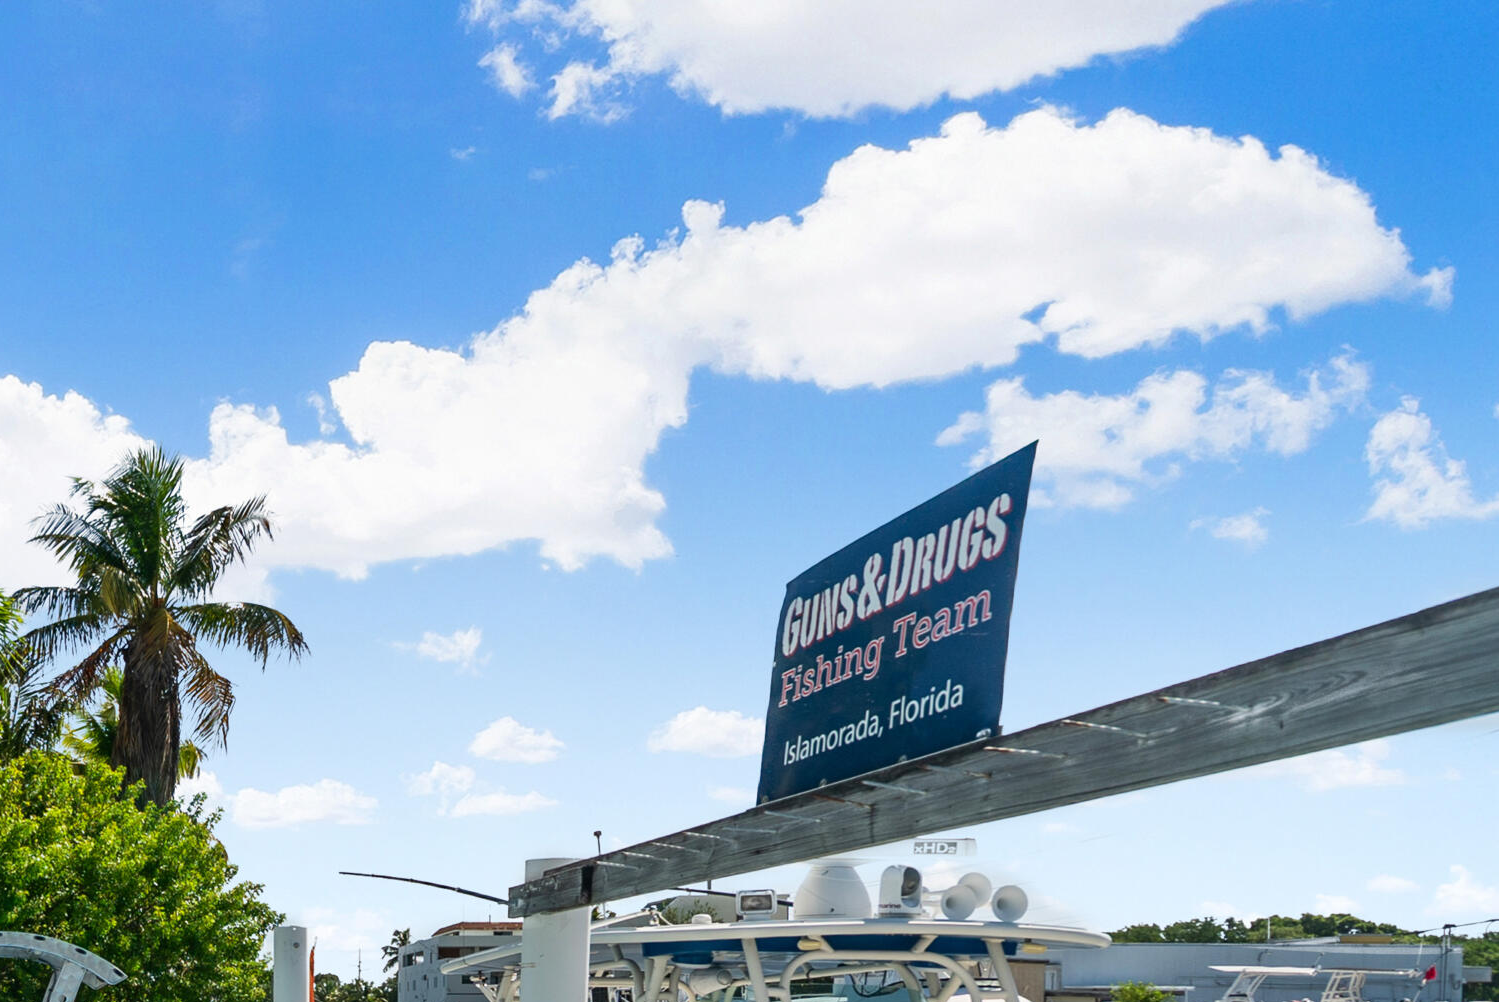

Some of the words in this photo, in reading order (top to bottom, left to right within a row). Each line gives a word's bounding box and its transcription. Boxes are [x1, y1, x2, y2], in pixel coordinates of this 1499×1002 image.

[781, 493, 1013, 658] GUNS&DRUGS
[778, 635, 885, 708] Fishing
[892, 589, 993, 659] Team
[783, 709, 884, 766] Islamorada,
[888, 679, 965, 730] Florida
